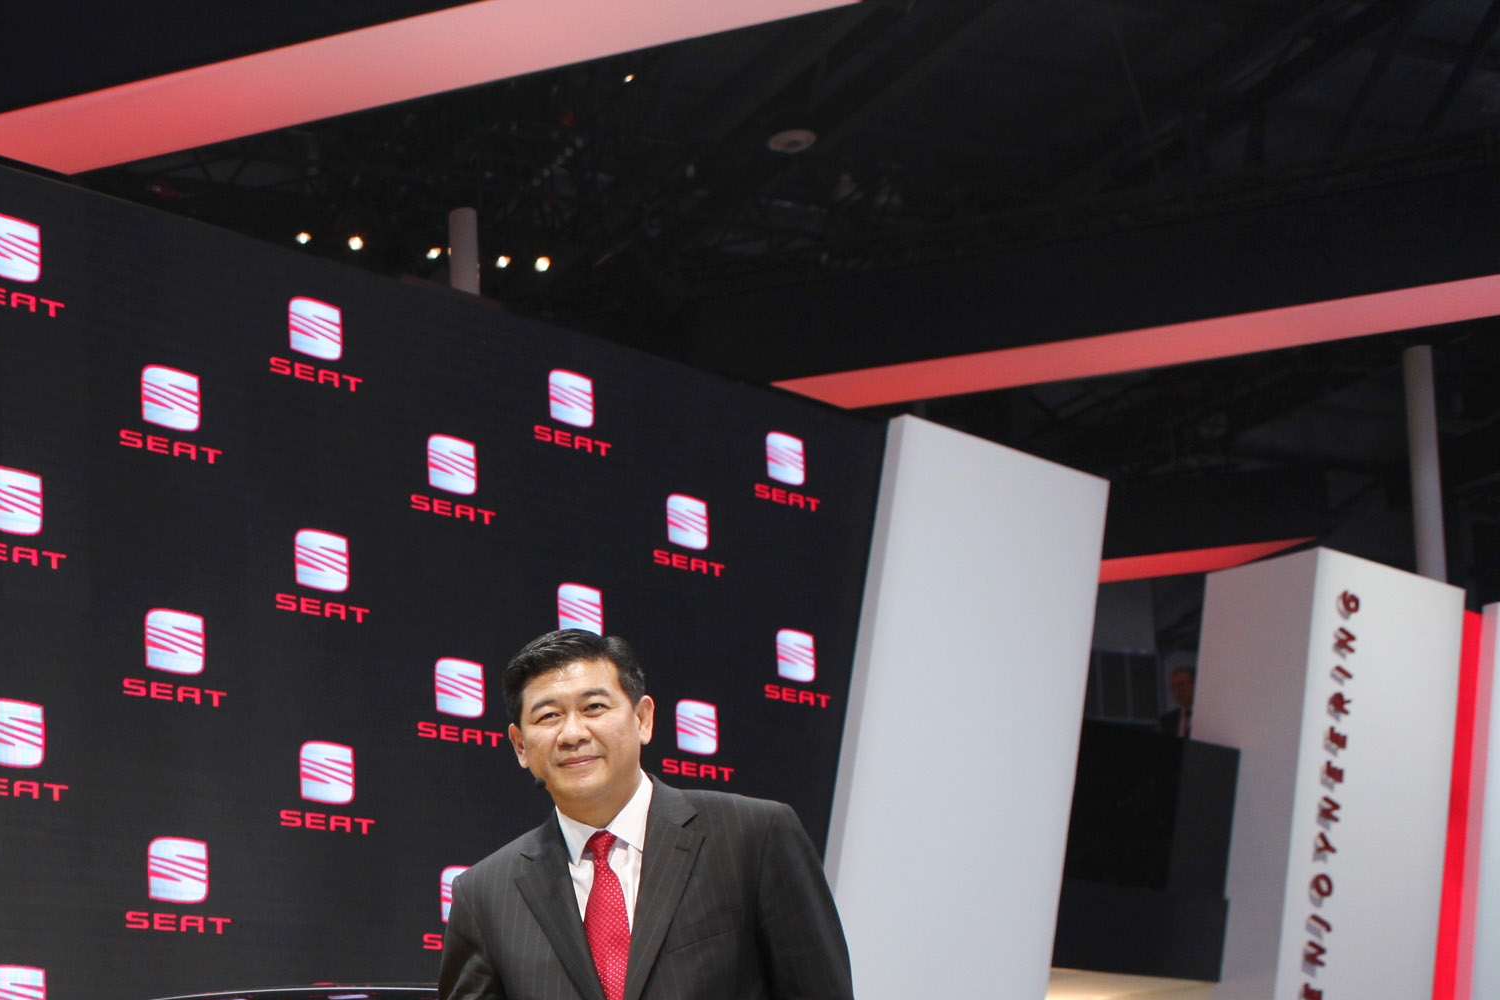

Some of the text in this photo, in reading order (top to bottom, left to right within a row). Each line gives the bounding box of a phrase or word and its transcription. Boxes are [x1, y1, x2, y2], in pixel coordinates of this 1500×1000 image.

[270, 357, 363, 393] SEAT
[120, 430, 222, 465] SEAT
[533, 425, 612, 456] SEAT
[411, 494, 497, 525] SEAT
[755, 483, 821, 512] SEAT
[653, 549, 725, 577] SEAT
[276, 592, 370, 624] SEAT
[123, 677, 227, 708] SEAT
[765, 684, 831, 708] SEAT
[417, 721, 503, 748] SEAT
[661, 758, 735, 782] SEAT
[280, 809, 376, 835] SEAT
[126, 910, 232, 935] SEAT
